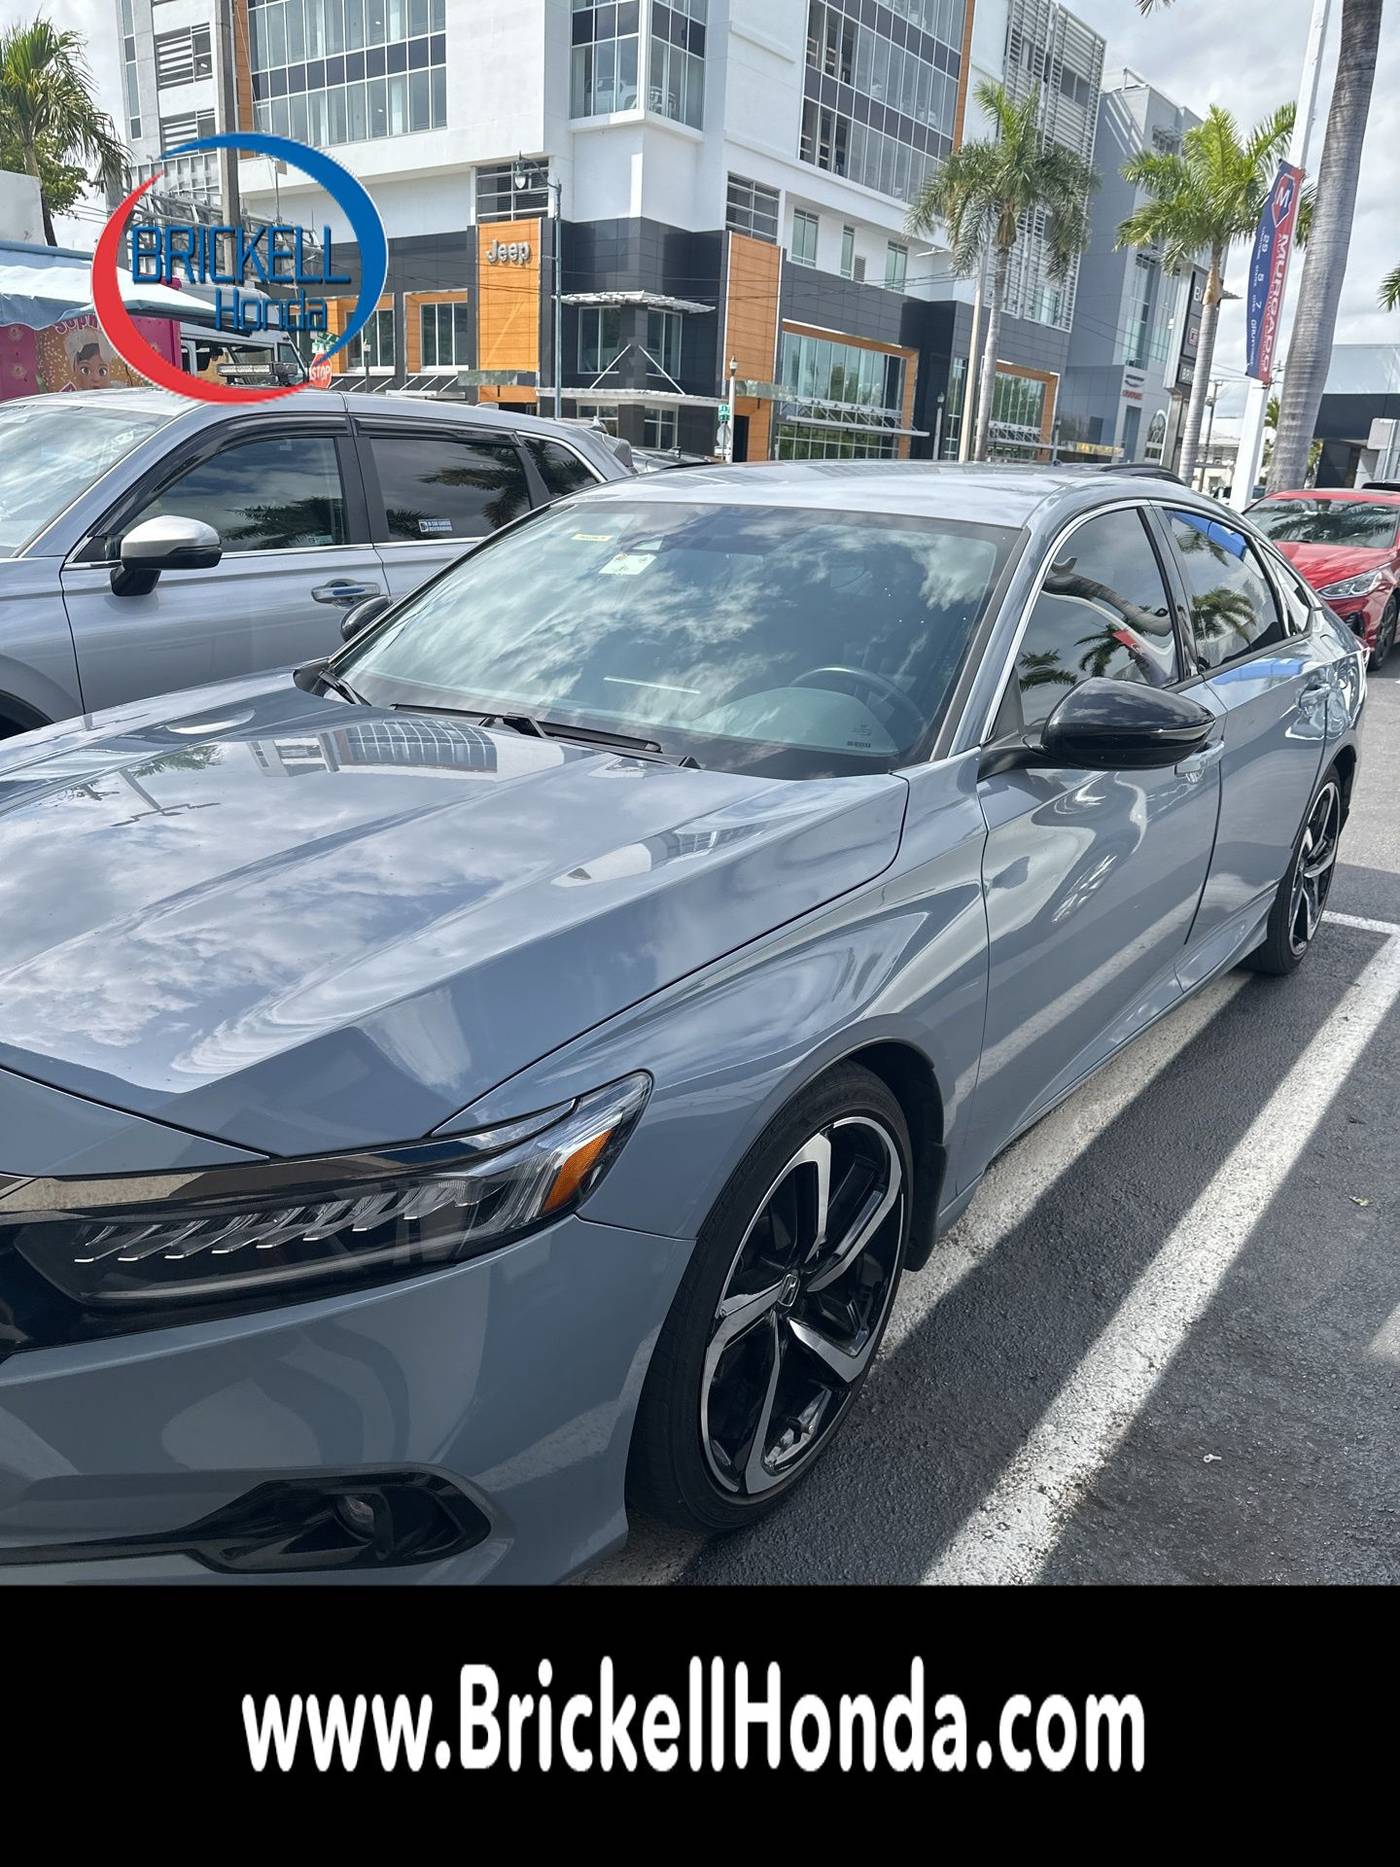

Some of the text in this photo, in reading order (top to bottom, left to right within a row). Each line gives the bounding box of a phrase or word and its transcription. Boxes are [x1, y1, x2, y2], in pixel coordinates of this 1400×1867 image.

[485, 239, 530, 265] Jeep
[1263, 234, 1290, 372] MURGADO
[311, 366, 331, 381] STOP
